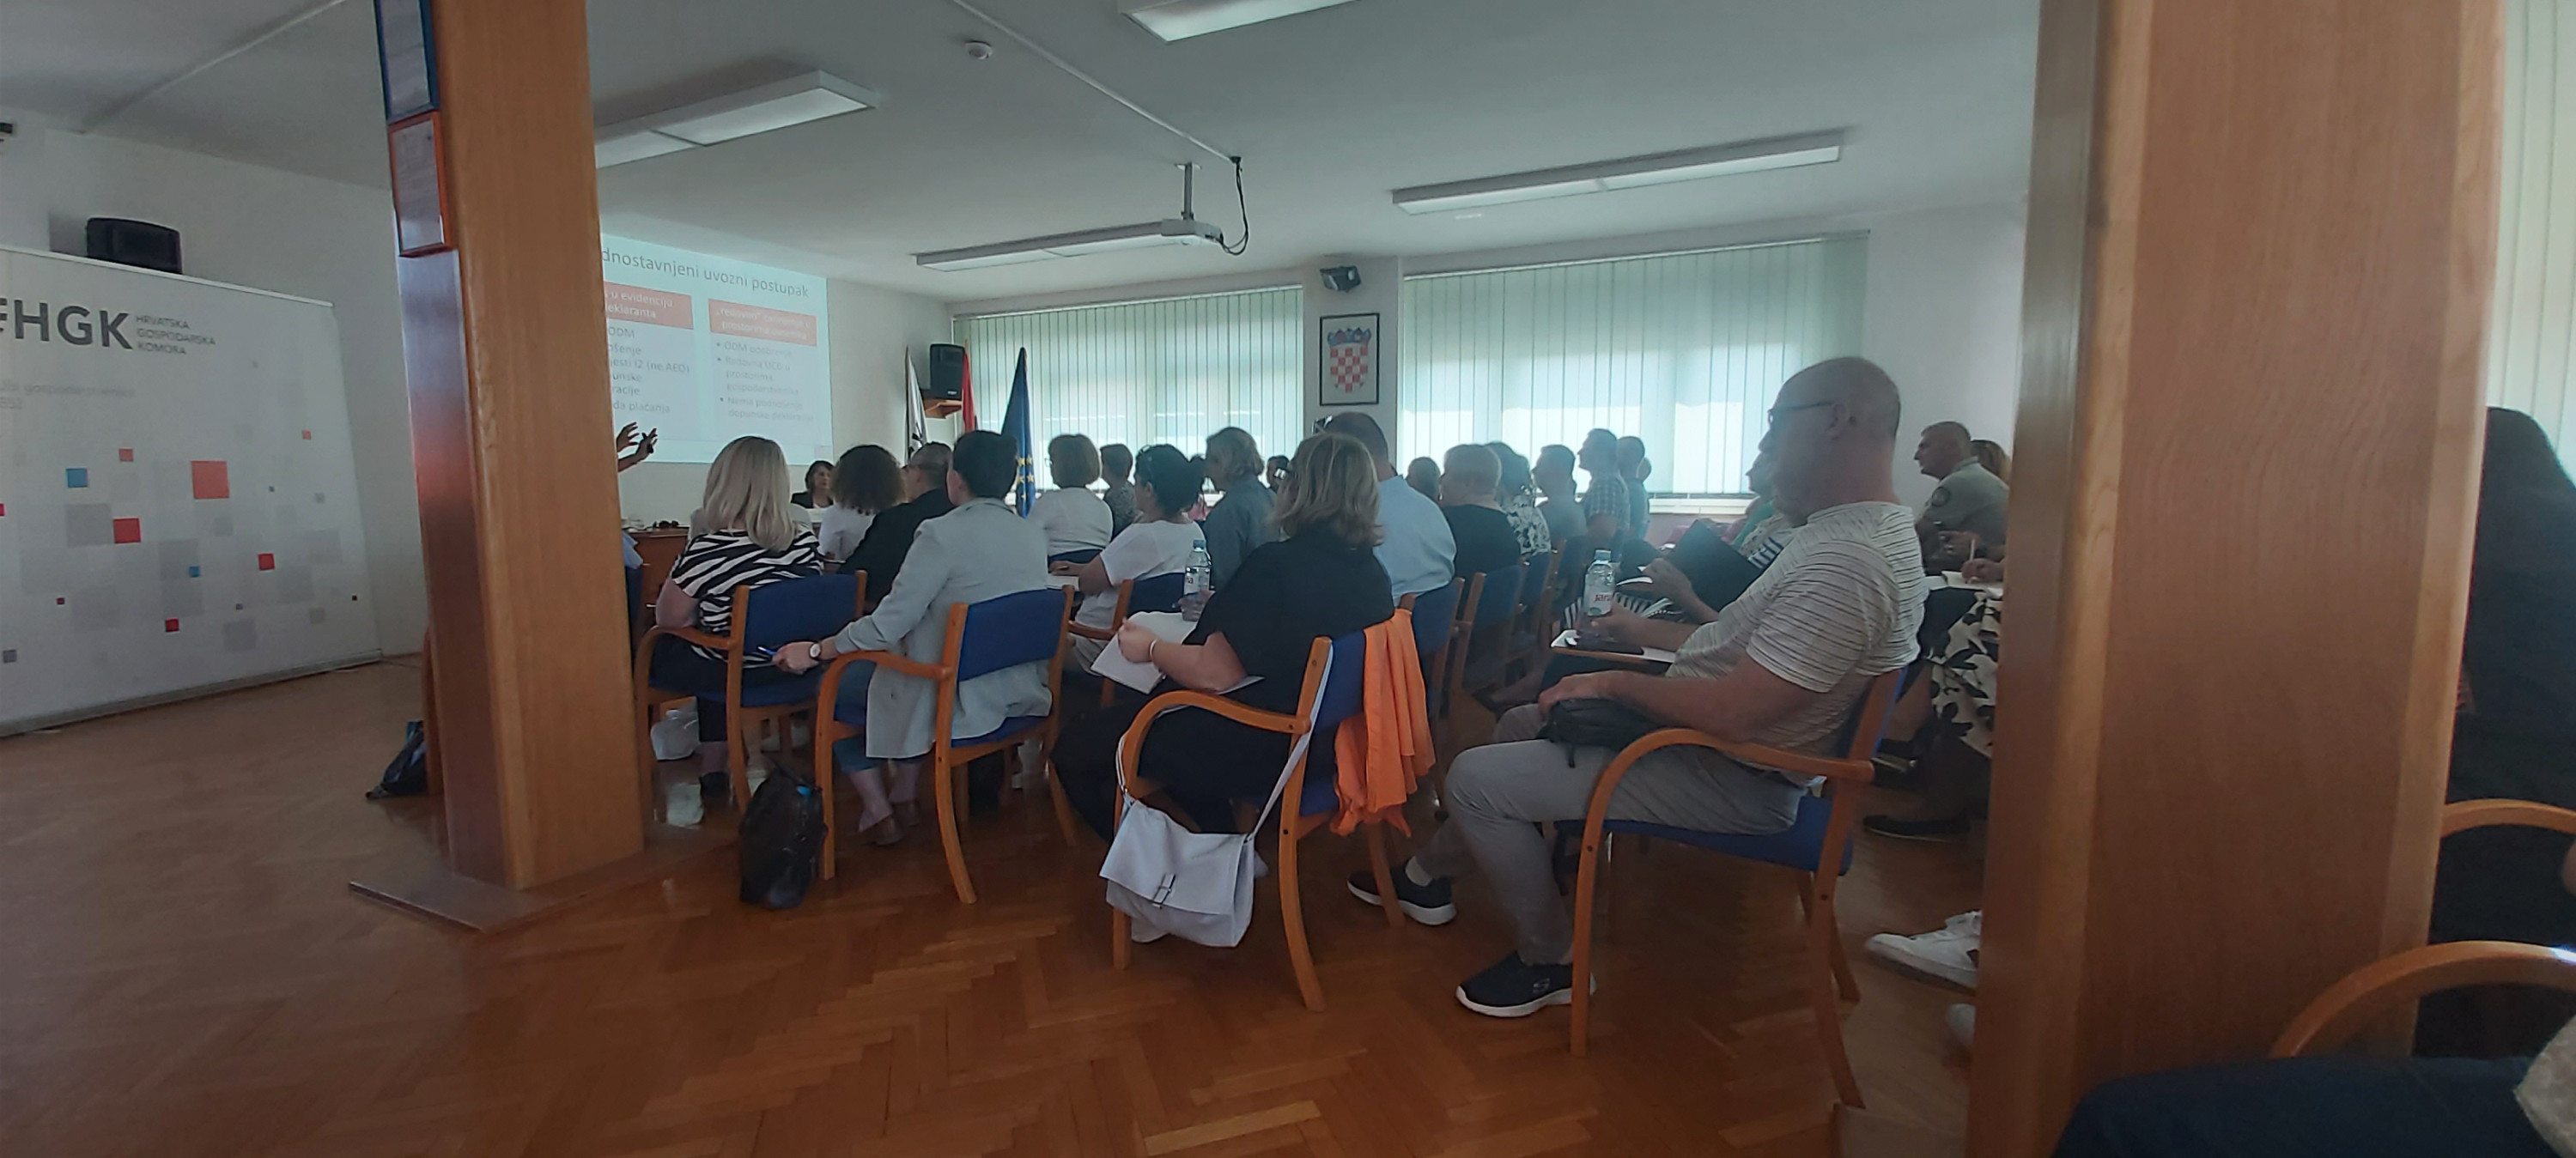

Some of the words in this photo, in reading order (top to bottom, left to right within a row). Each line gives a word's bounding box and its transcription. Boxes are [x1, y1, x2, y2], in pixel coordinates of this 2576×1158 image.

[703, 270, 748, 286] uvozni
[751, 278, 809, 297] postupak
[621, 293, 673, 308] evidenciju
[14, 300, 133, 349] HGK
[136, 315, 190, 329] HRVATSKA
[137, 328, 216, 345] GOSPODARSKA
[609, 326, 635, 337] ODM
[138, 343, 186, 355] KOMORA
